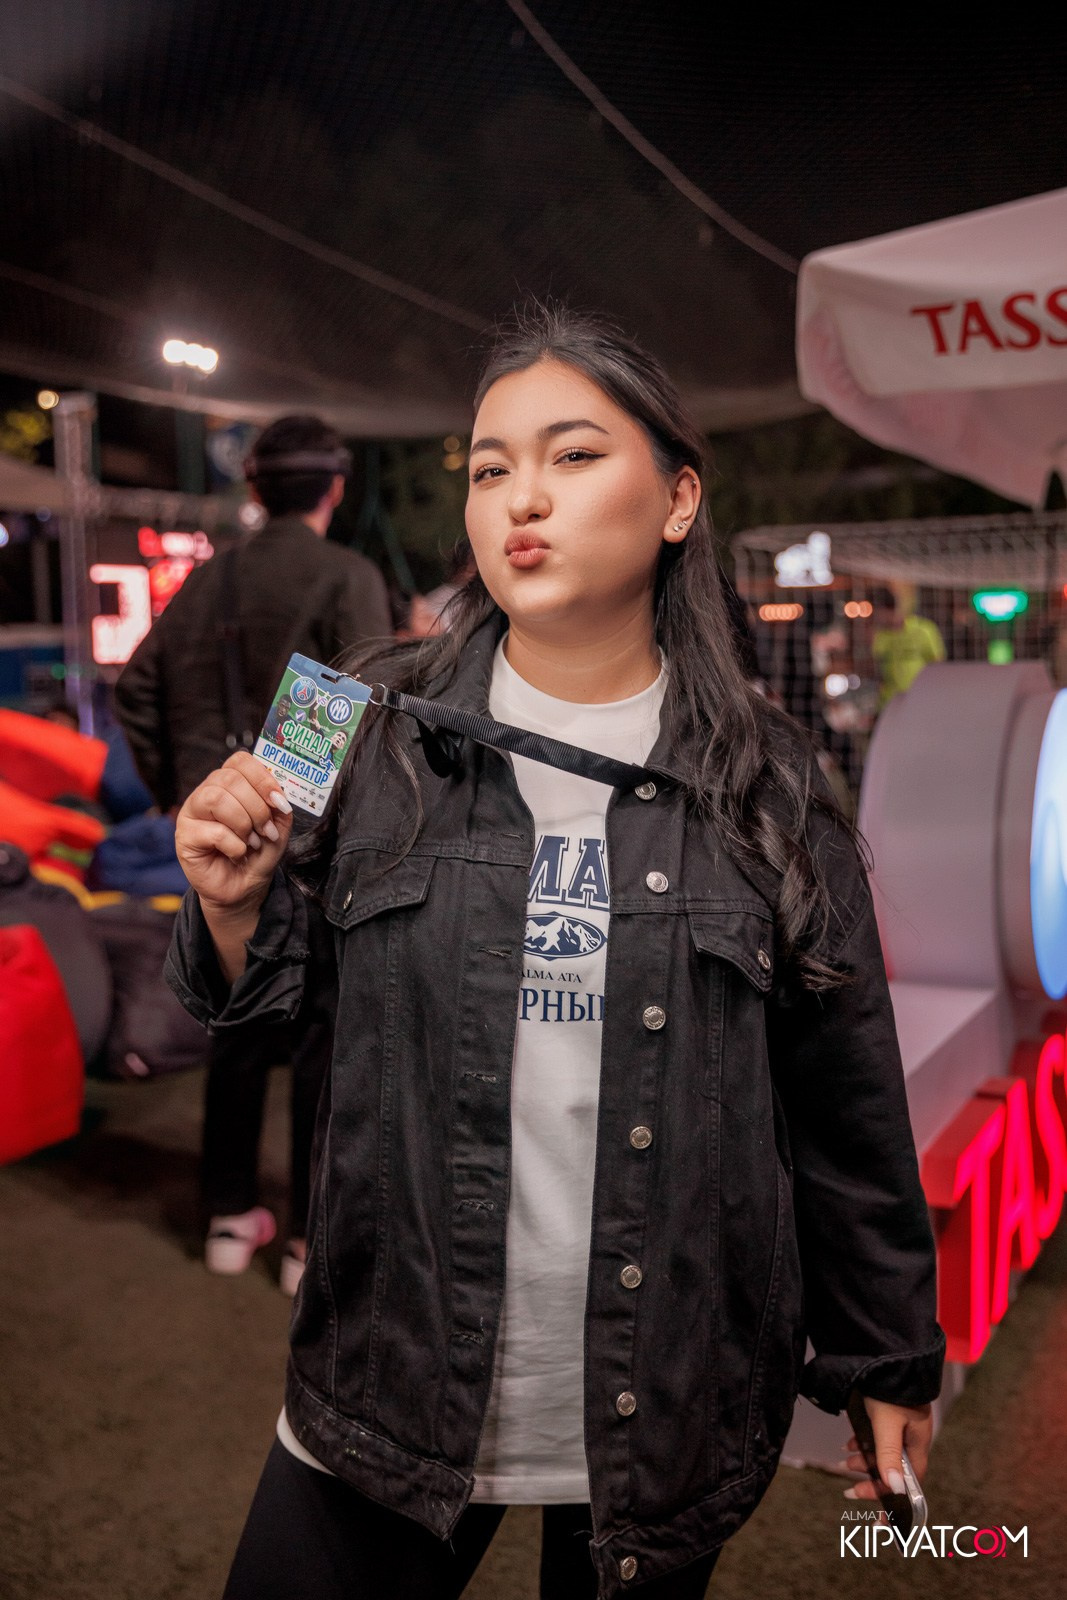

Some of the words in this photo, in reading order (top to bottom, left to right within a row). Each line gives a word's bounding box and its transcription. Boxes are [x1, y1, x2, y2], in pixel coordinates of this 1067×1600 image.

[282, 721, 332, 758] ФИНАЛ
[262, 743, 329, 786] ОРГАНИЗАТОР
[558, 973, 582, 984] ATA
